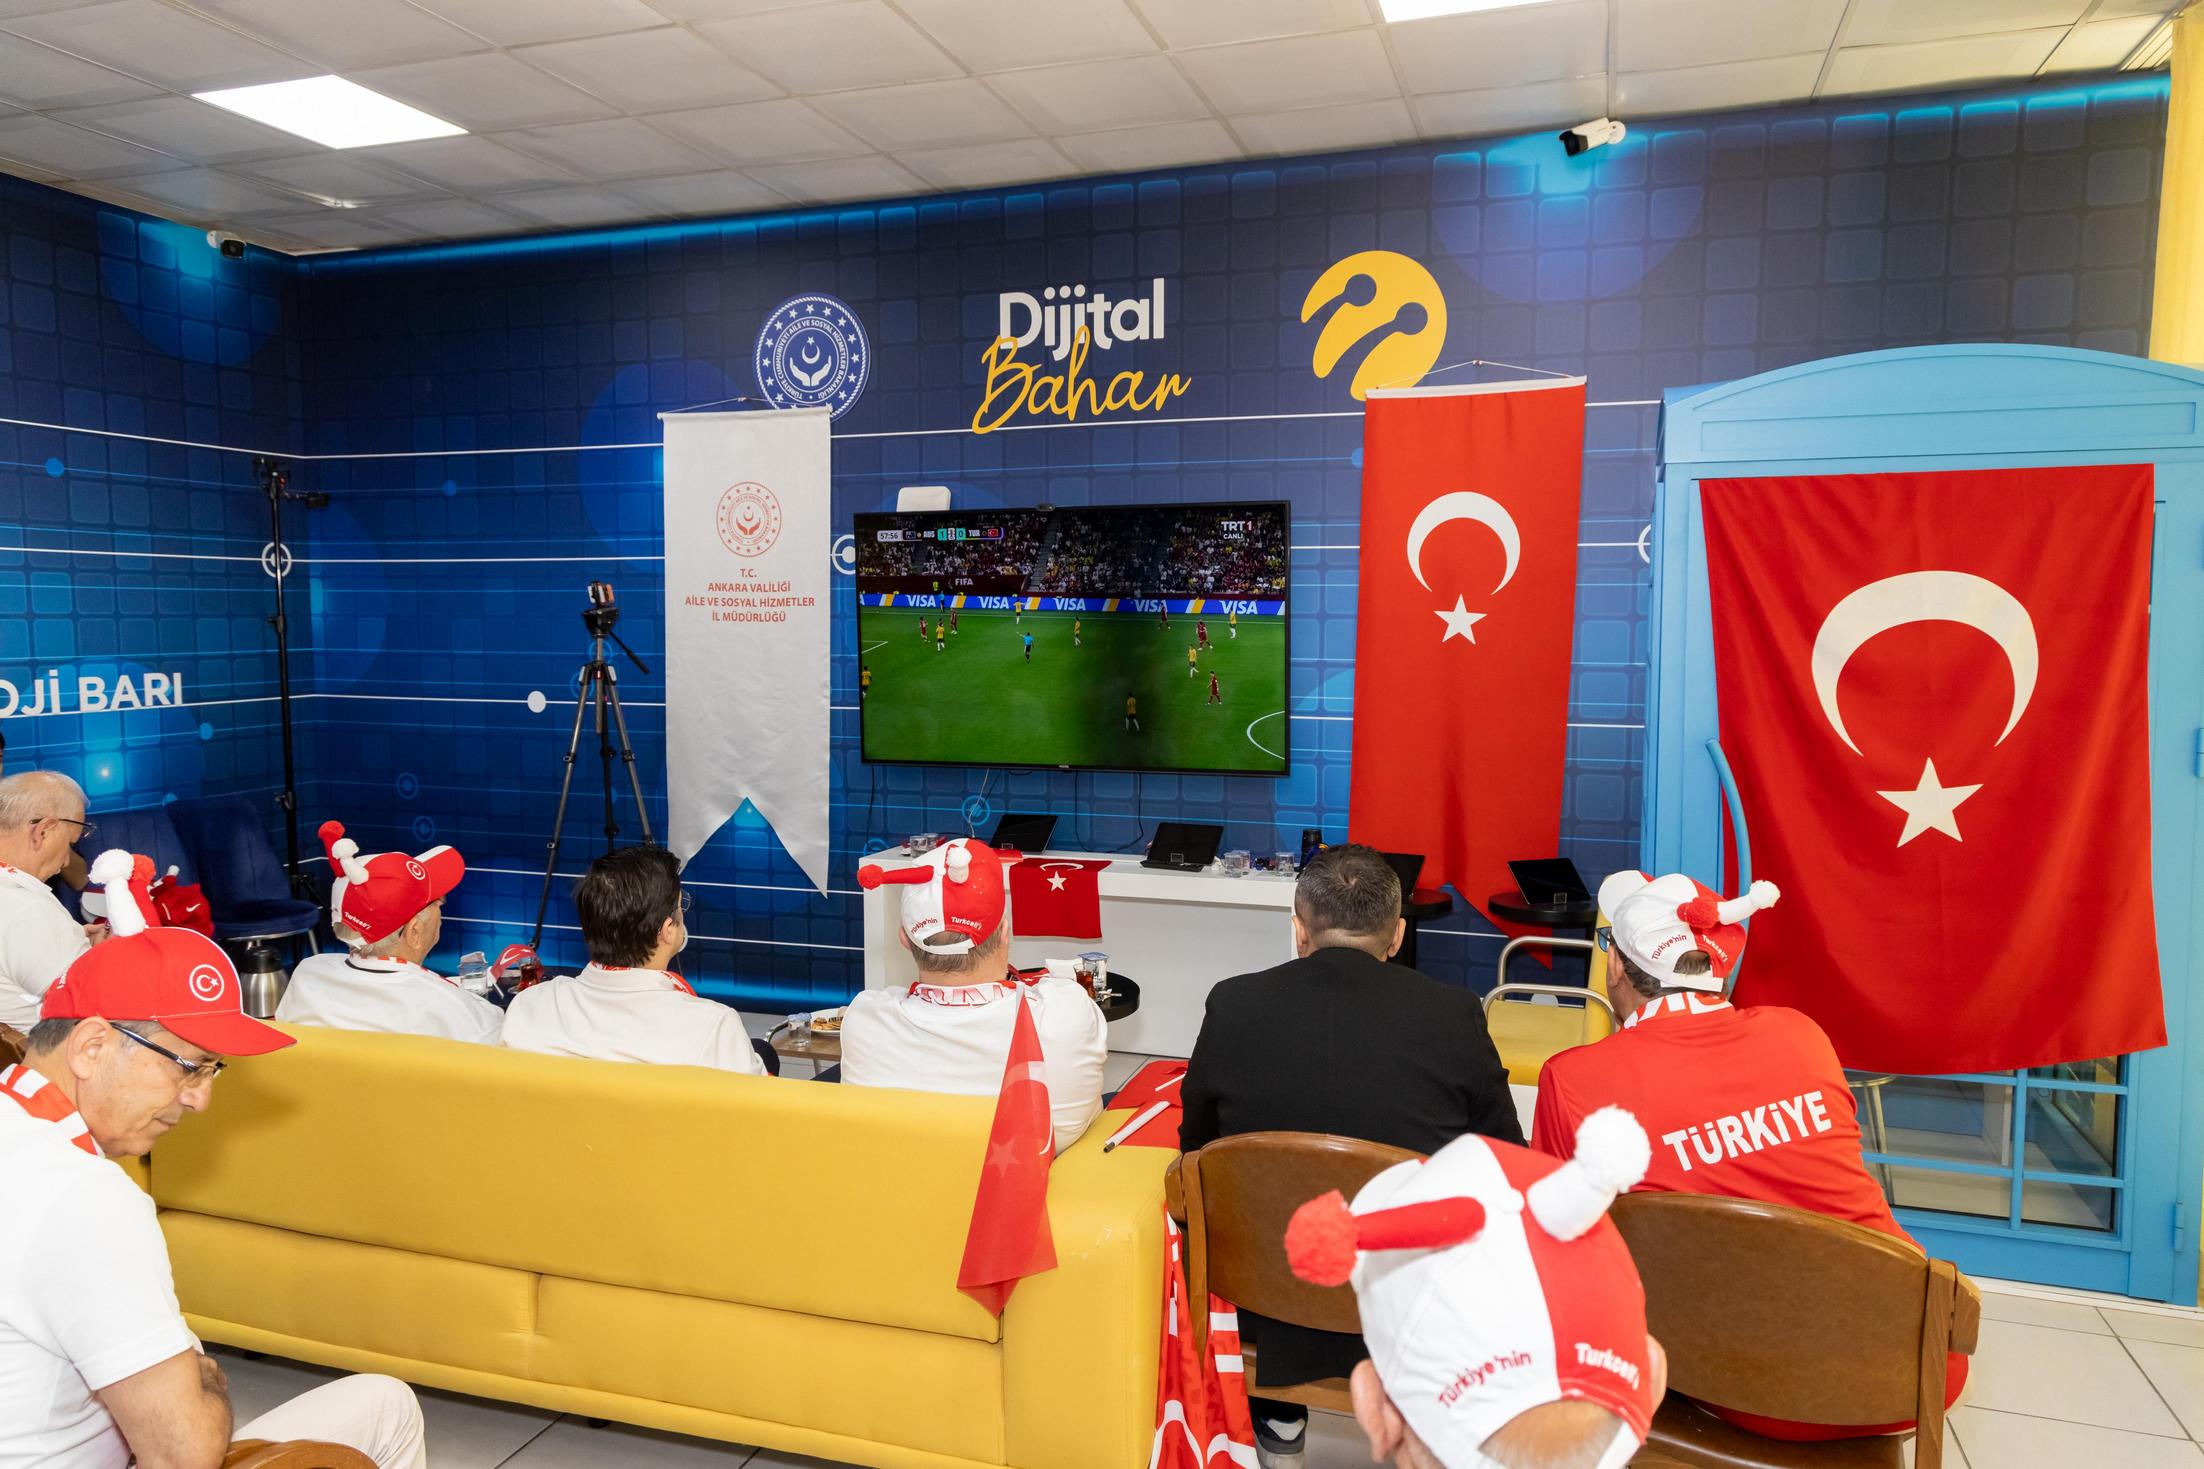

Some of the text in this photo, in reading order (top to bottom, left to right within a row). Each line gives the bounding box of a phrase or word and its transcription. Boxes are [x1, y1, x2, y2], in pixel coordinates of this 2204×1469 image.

[1000, 278, 1164, 361] Dijital
[788, 322, 801, 335] AİLE
[811, 319, 833, 334] SOSYAL
[832, 330, 847, 369] HİZMETLER
[818, 369, 845, 399] BAKANLIĞI
[972, 325, 1192, 435] Bahar
[1221, 521, 1252, 531] TRT 1
[740, 568, 757, 578] T.C.
[708, 580, 791, 593] ANKARA VALİLİĞİ
[955, 578, 974, 586] FIFA
[685, 595, 815, 608] AİLE VE SOSYAL HİZMETLER
[905, 594, 936, 607] VISA
[977, 596, 1010, 609] VISA
[1053, 598, 1087, 611] VISA
[1219, 601, 1258, 614] VISA
[712, 610, 786, 622] İL MÜDÜRLÜĞÜ
[78, 672, 183, 712] BARI
[1652, 934, 1687, 960] Türkiye'nin
[1662, 1090, 1832, 1171] TÜRKİYE
[1438, 1350, 1532, 1408] Türkiye'nin
